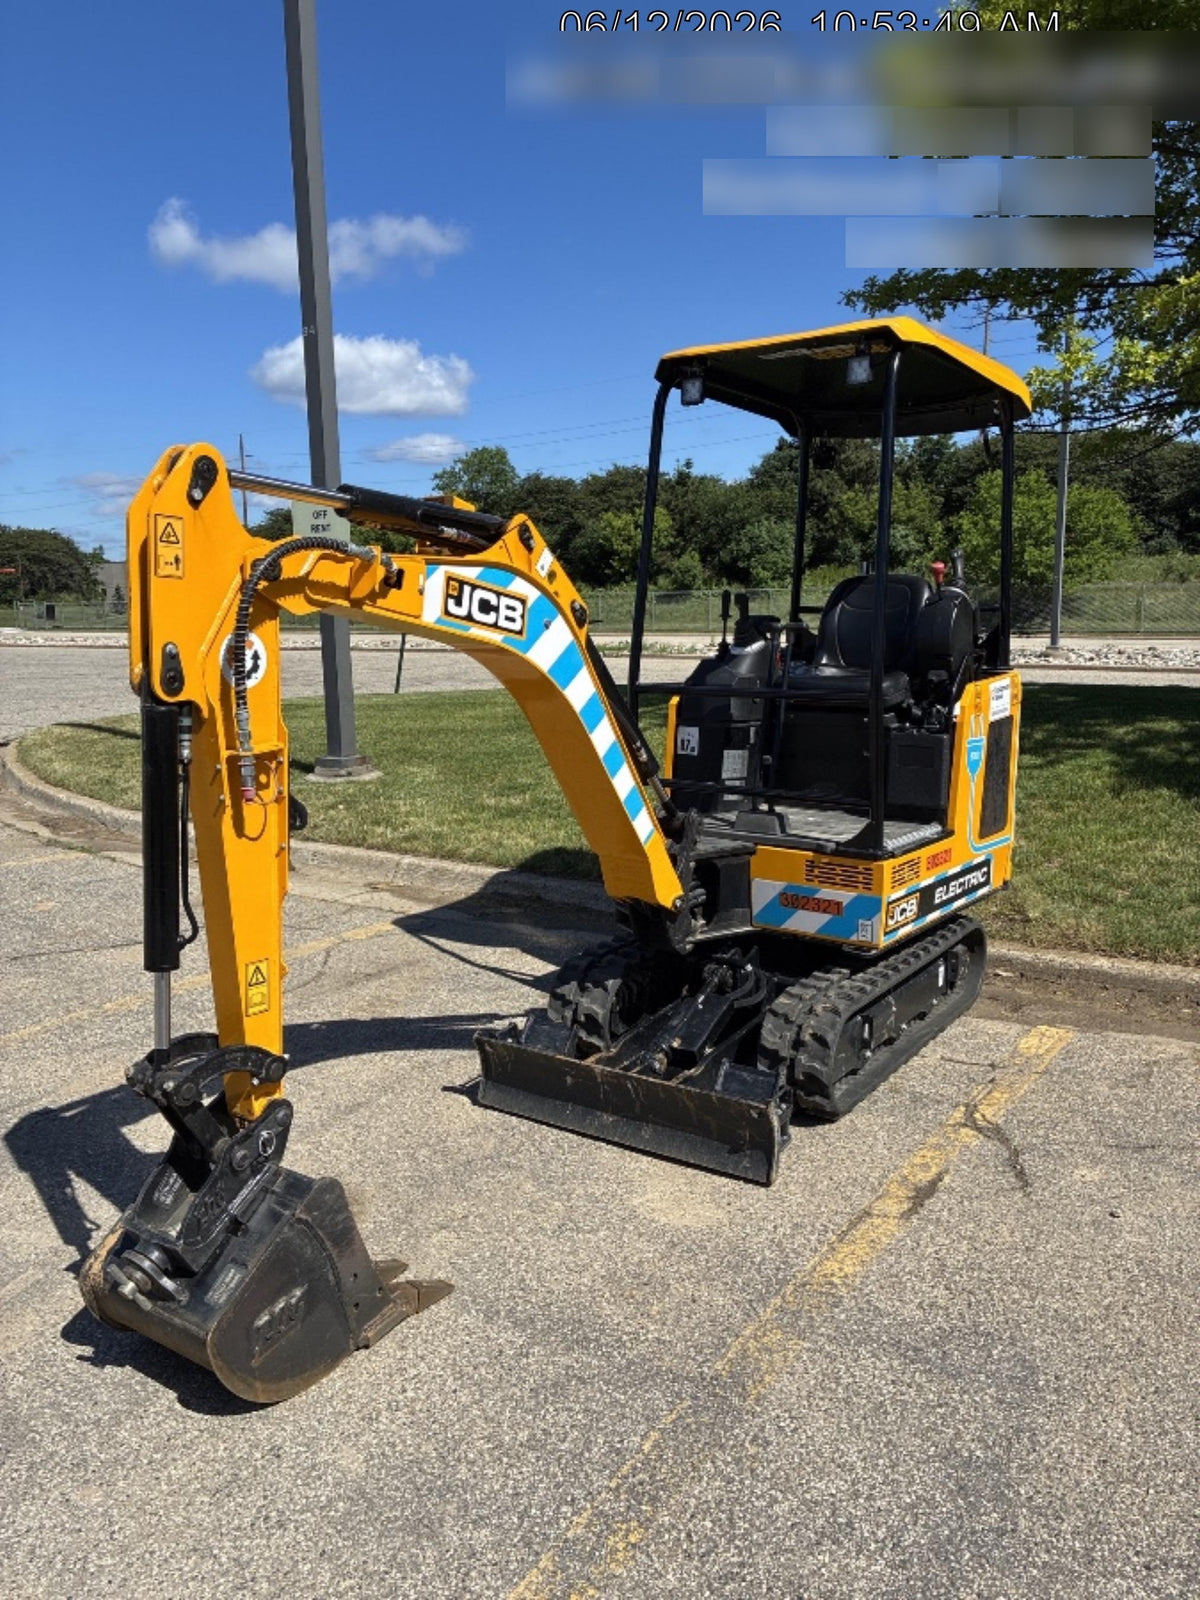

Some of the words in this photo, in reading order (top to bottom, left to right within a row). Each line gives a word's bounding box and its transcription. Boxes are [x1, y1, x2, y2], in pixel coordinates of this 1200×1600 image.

[312, 510, 328, 520] OFF
[447, 583, 524, 632] JCB
[887, 898, 917, 926] JCB
[934, 867, 988, 904] ELECTRIC
